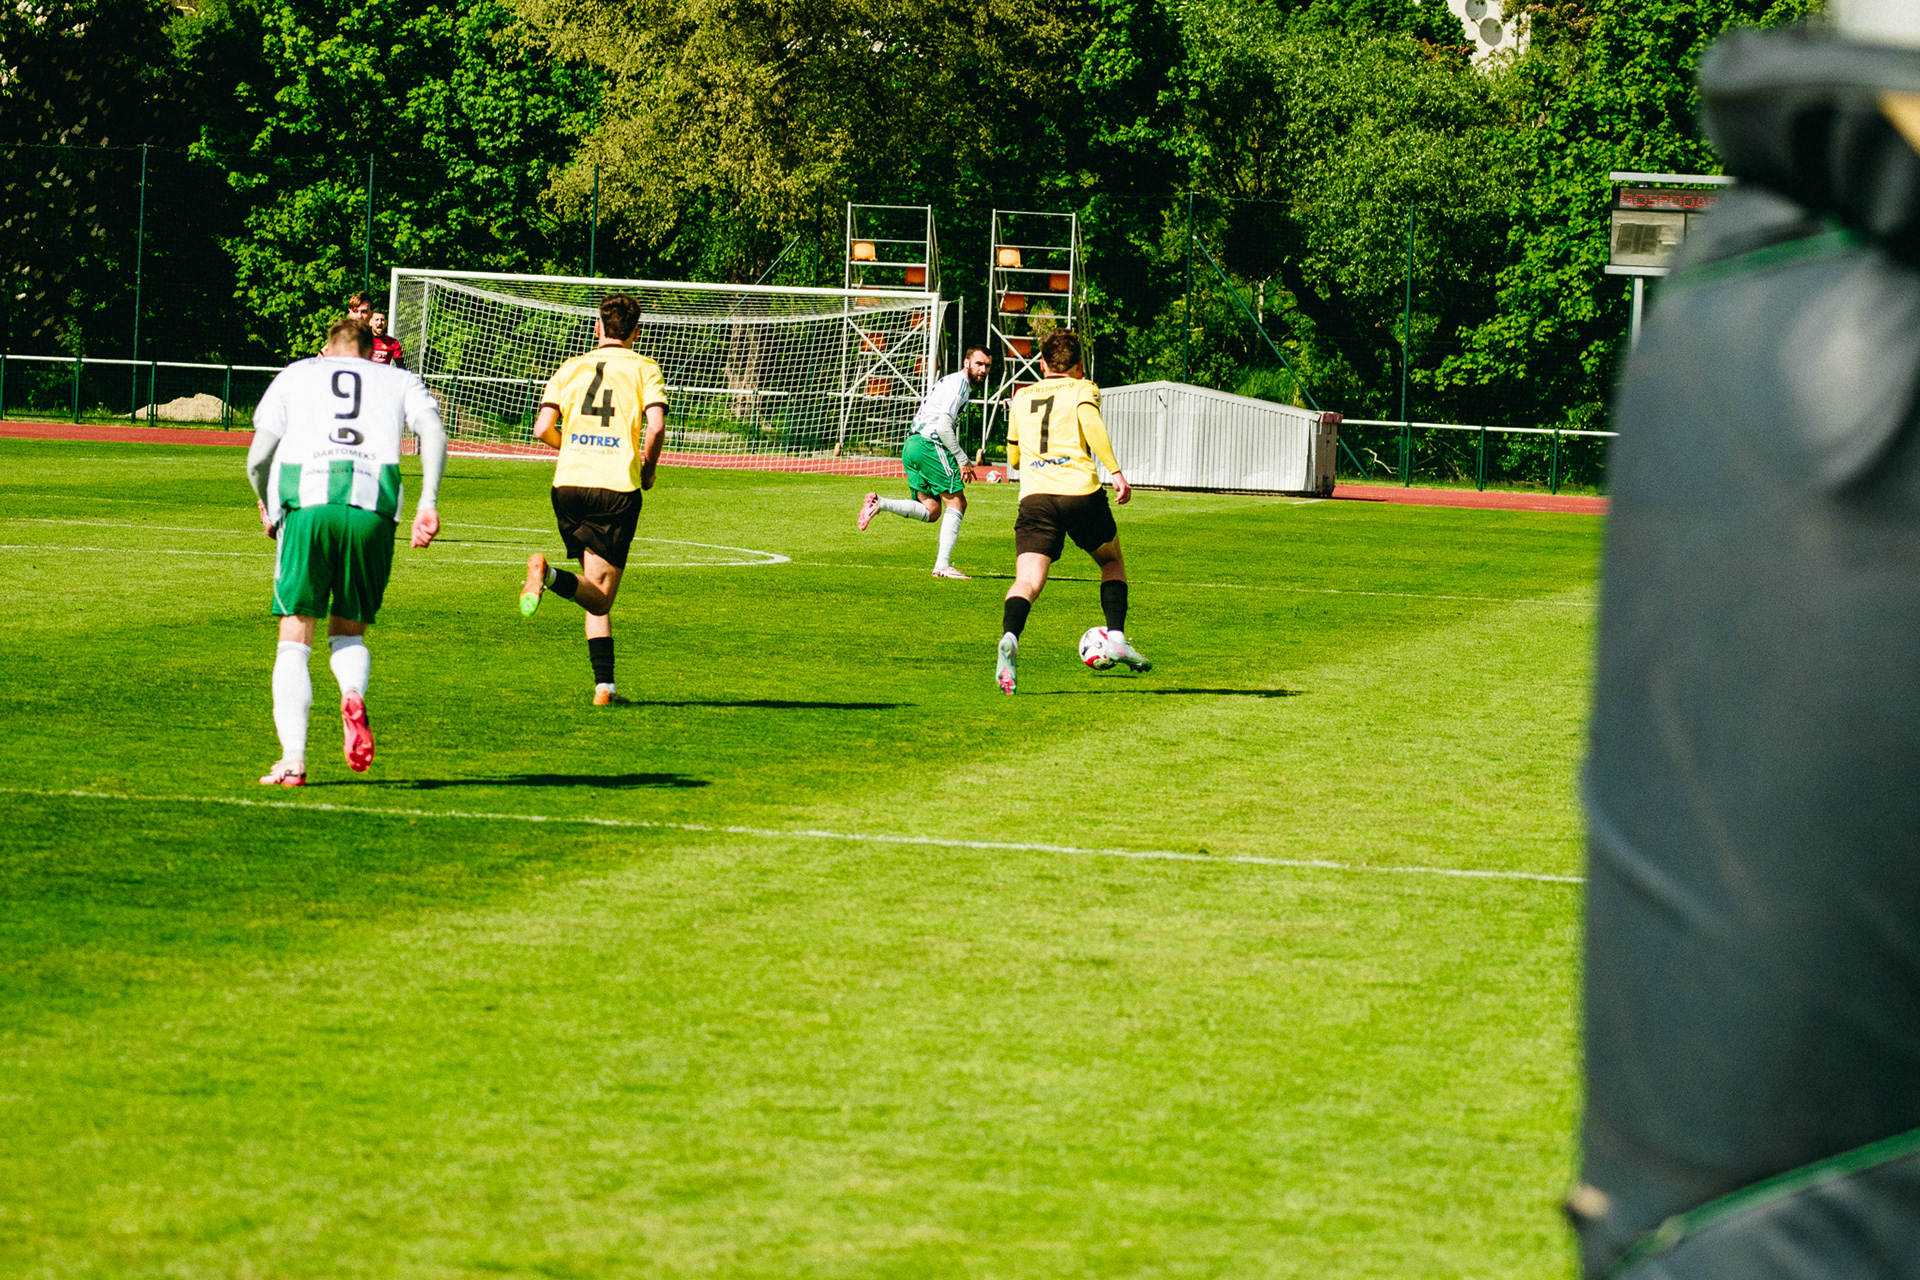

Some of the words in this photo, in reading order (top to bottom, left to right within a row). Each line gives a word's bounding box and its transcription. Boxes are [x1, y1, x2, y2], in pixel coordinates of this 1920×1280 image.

[331, 370, 362, 419] 9
[581, 361, 616, 427] 4
[571, 433, 621, 448] POTREX
[1030, 394, 1055, 454] 7
